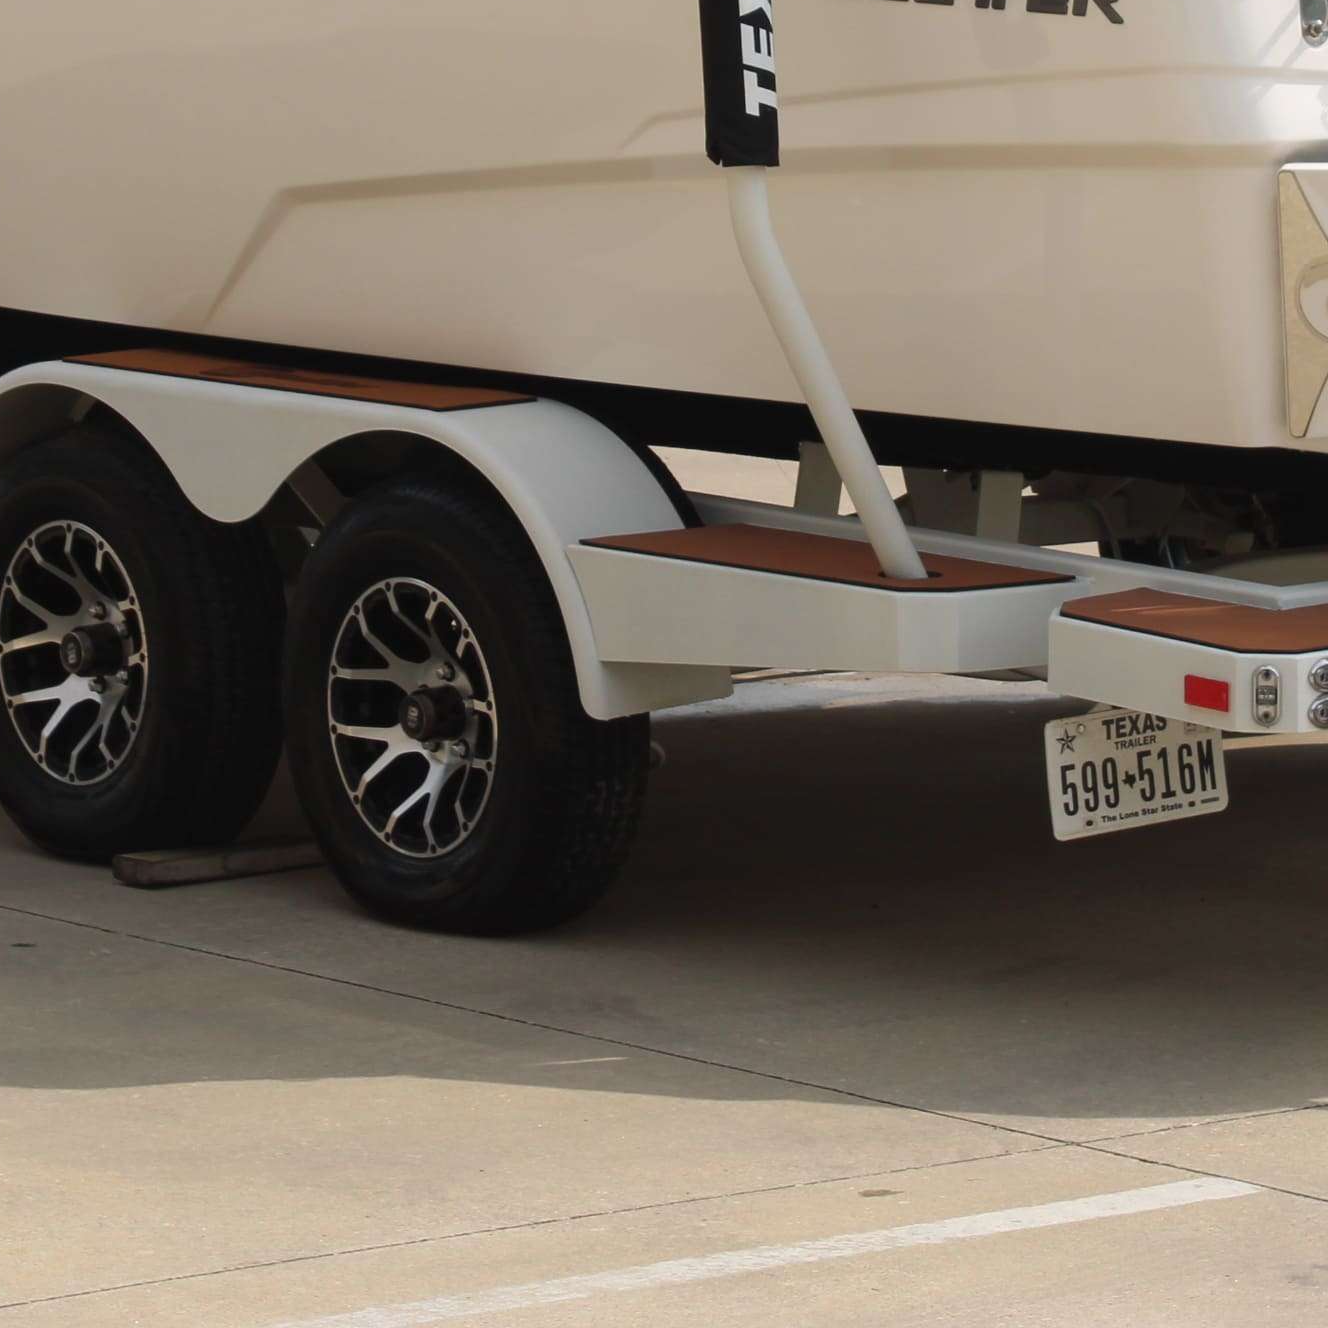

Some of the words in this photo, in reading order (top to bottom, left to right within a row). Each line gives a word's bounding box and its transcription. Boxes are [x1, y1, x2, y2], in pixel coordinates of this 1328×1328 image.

[1102, 713, 1167, 741] TEXAS
[1114, 734, 1157, 751] TRAILER
[1060, 756, 1120, 817] 599
[1136, 738, 1217, 803] 516M
[1101, 814, 1117, 823] The
[1119, 810, 1140, 820] Lone
[1142, 806, 1159, 816] Star
[1161, 802, 1183, 812] State
